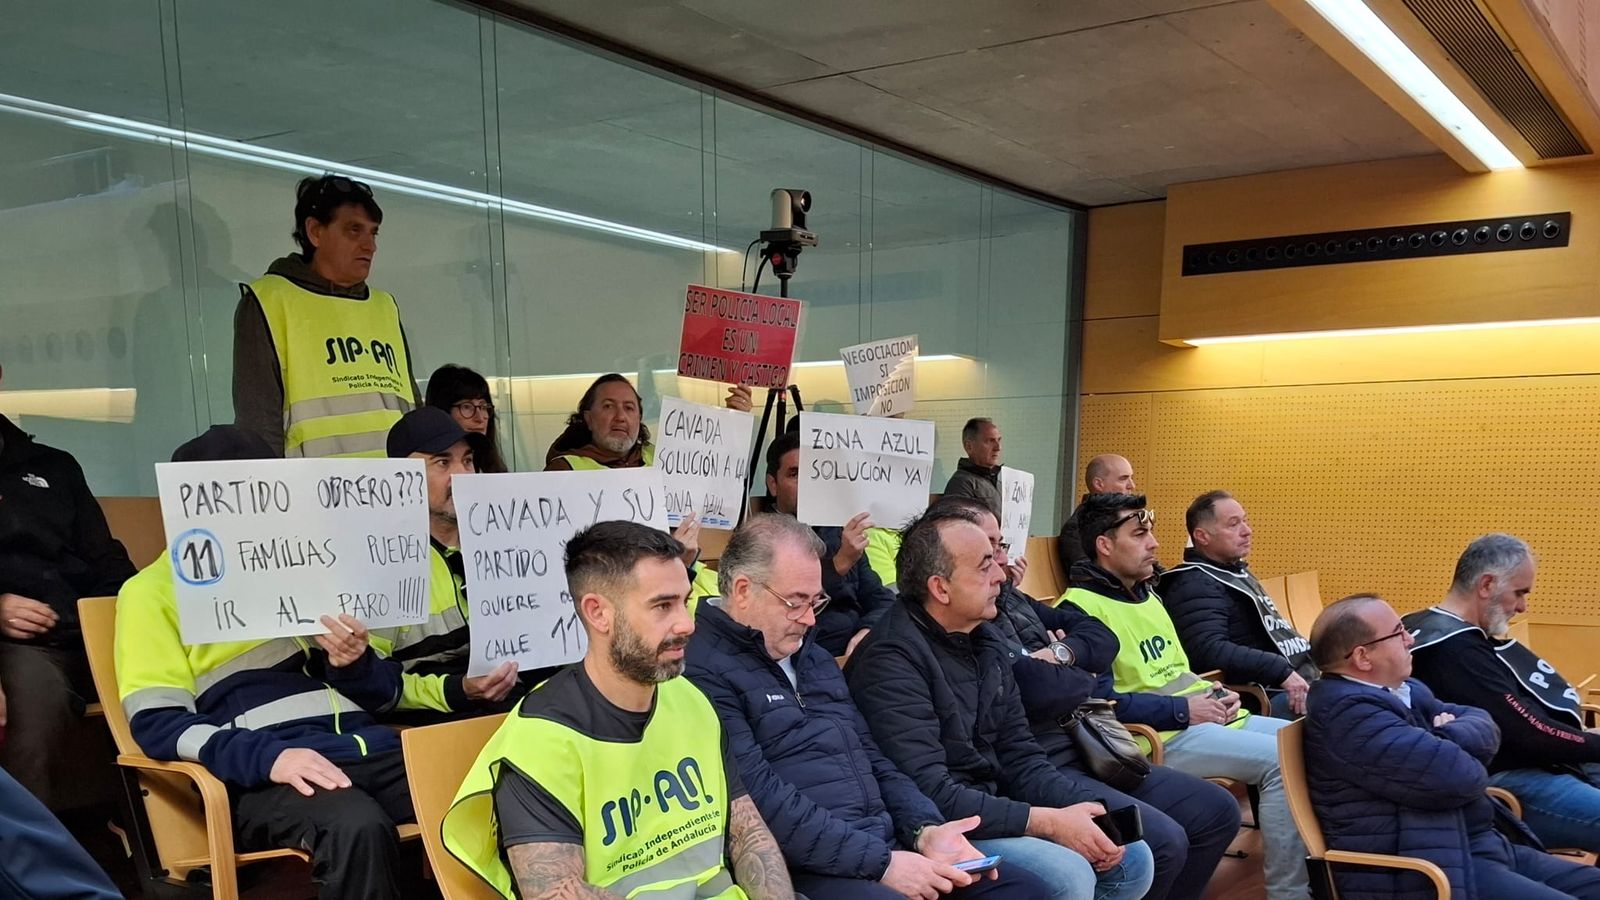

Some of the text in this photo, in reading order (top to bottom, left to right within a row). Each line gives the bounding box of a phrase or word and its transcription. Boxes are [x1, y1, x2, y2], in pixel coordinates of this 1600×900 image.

[684, 290, 707, 315] SER
[762, 302, 797, 327] LOCAL
[722, 328, 758, 354] ES UN
[842, 340, 913, 366] NEGOCIACION
[678, 353, 787, 387] CRIMEN Y CASTIGO
[880, 363, 889, 378] SI
[854, 377, 911, 402] IMPOSICION
[880, 400, 893, 414] NO
[665, 409, 723, 445] CAVADA
[812, 429, 928, 454] ZONA AZUL
[723, 455, 730, 478] A
[811, 456, 891, 483] SOLUCIÓN
[180, 475, 290, 518] PARTIDO
[468, 487, 655, 536] CAVADA Y SU
[664, 485, 725, 517] ONA AZUL
[183, 538, 219, 580] 11
[367, 534, 428, 567] PUEDEN
[473, 545, 548, 581] PARTIDO
[213, 597, 247, 631] IR
[276, 596, 315, 625] AL
[480, 593, 541, 617] QUIERE
[485, 633, 532, 662] CALLE
[656, 846, 669, 857] de
[671, 824, 717, 850] Andalucía
